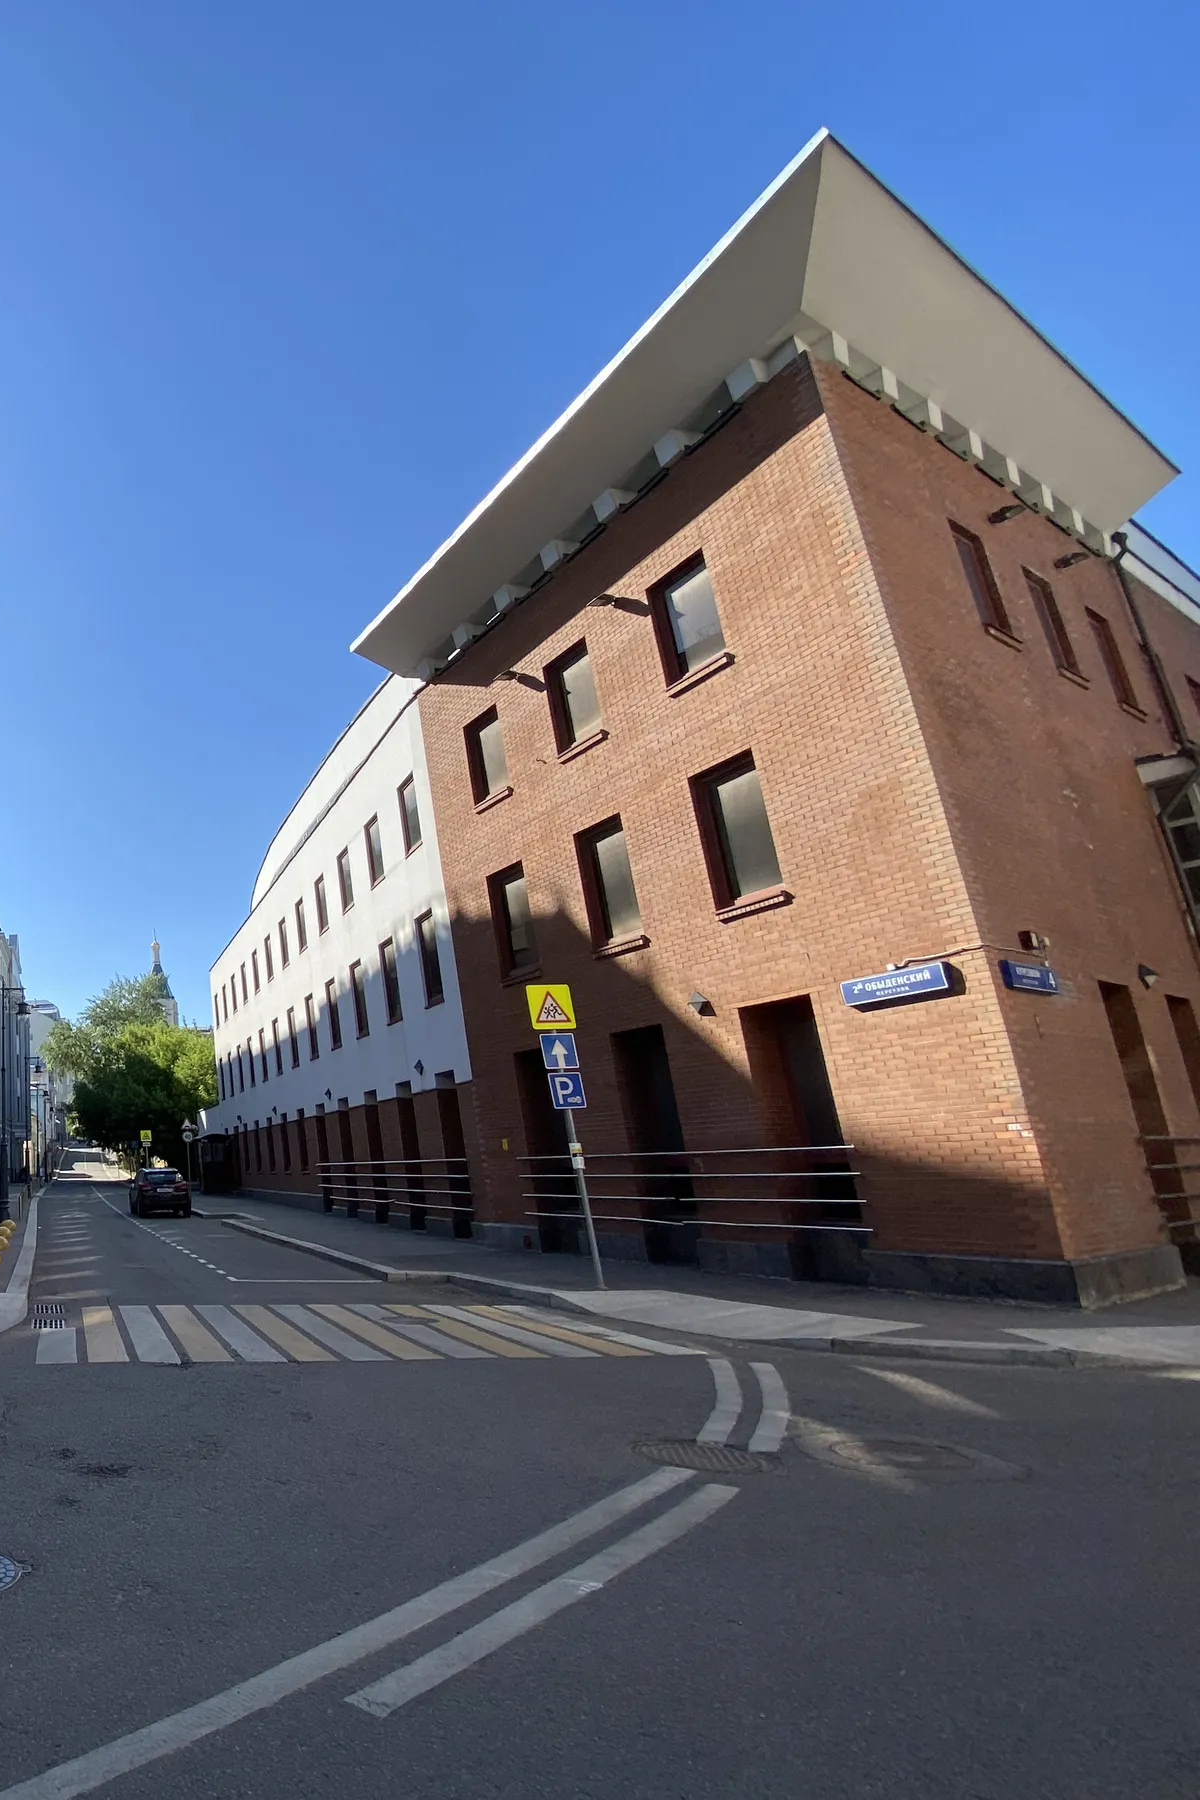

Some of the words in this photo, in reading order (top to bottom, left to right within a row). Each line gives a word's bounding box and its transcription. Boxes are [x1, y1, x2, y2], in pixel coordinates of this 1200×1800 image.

[865, 970, 931, 992] ОБЫДЕНСКИЙ
[1049, 972, 1056, 988] 4
[876, 986, 910, 996] ПЕРЕУЛОК
